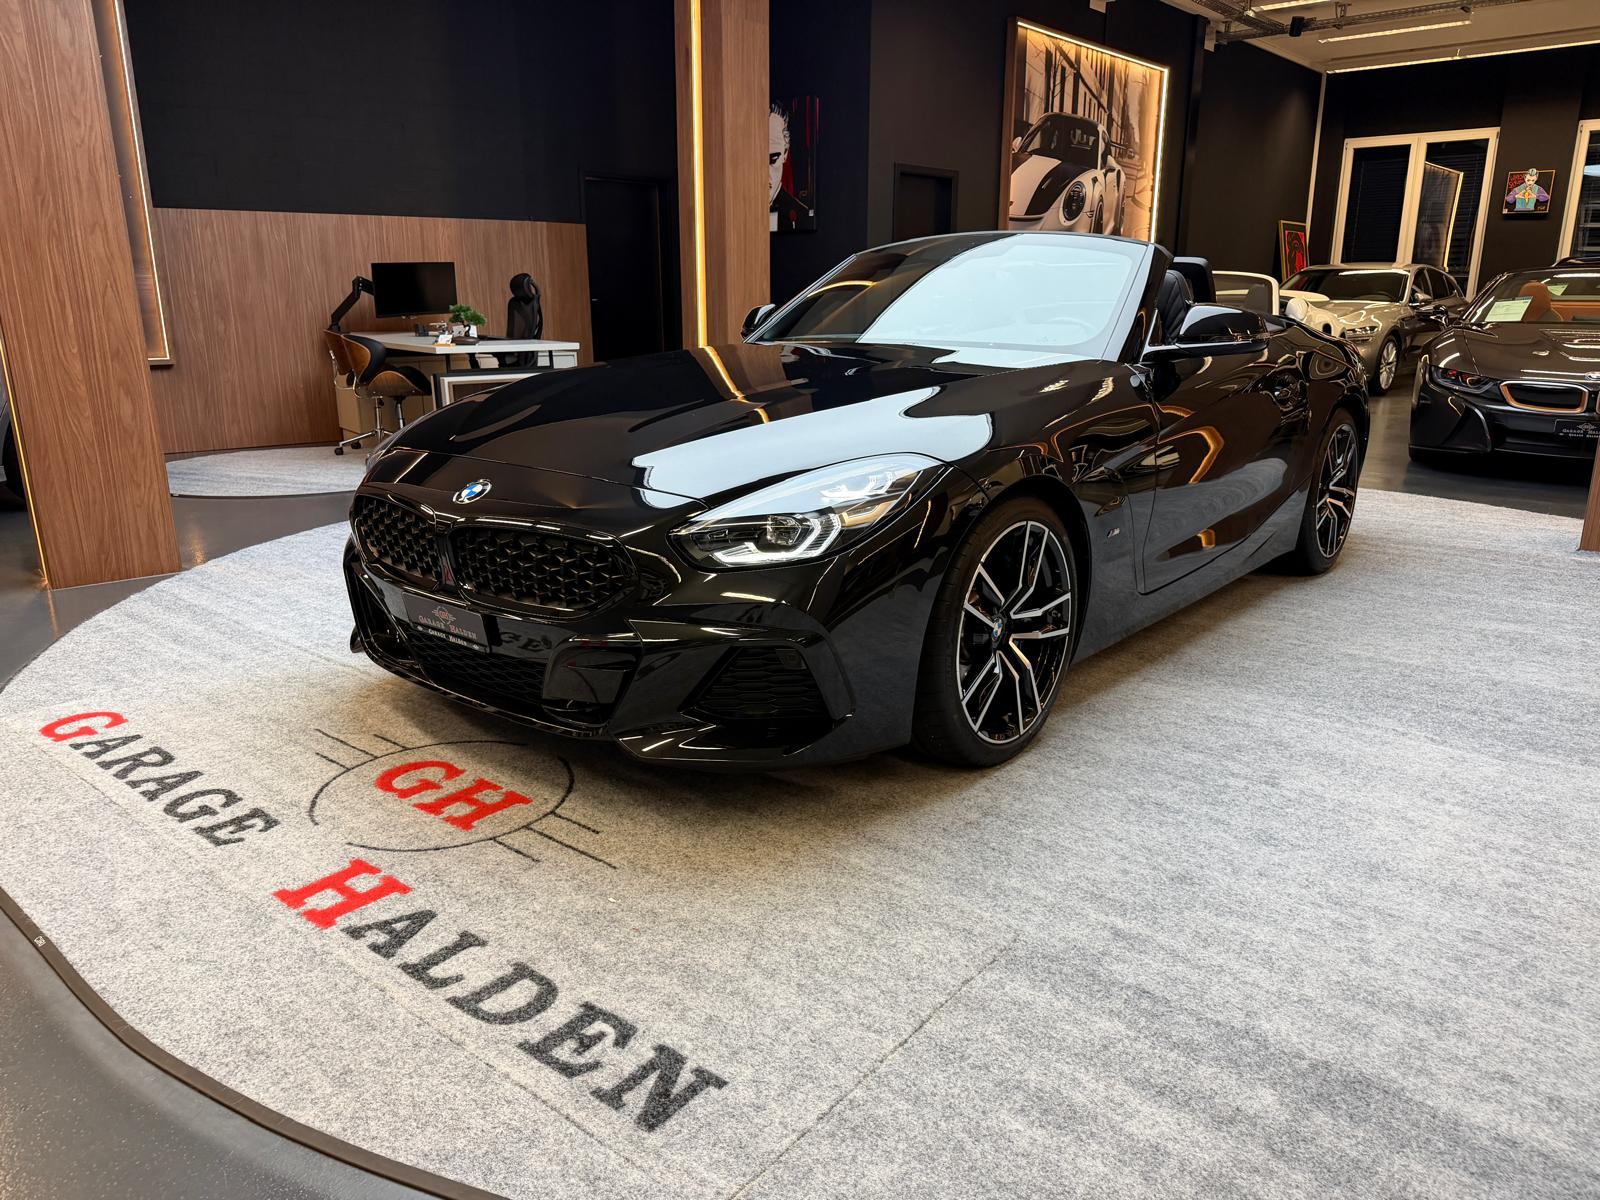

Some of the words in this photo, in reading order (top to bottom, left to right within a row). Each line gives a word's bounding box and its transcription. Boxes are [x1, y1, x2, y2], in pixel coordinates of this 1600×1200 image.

[39, 711, 281, 847] GARAGE
[374, 759, 532, 831] GH
[273, 857, 729, 1133] HALDEN
